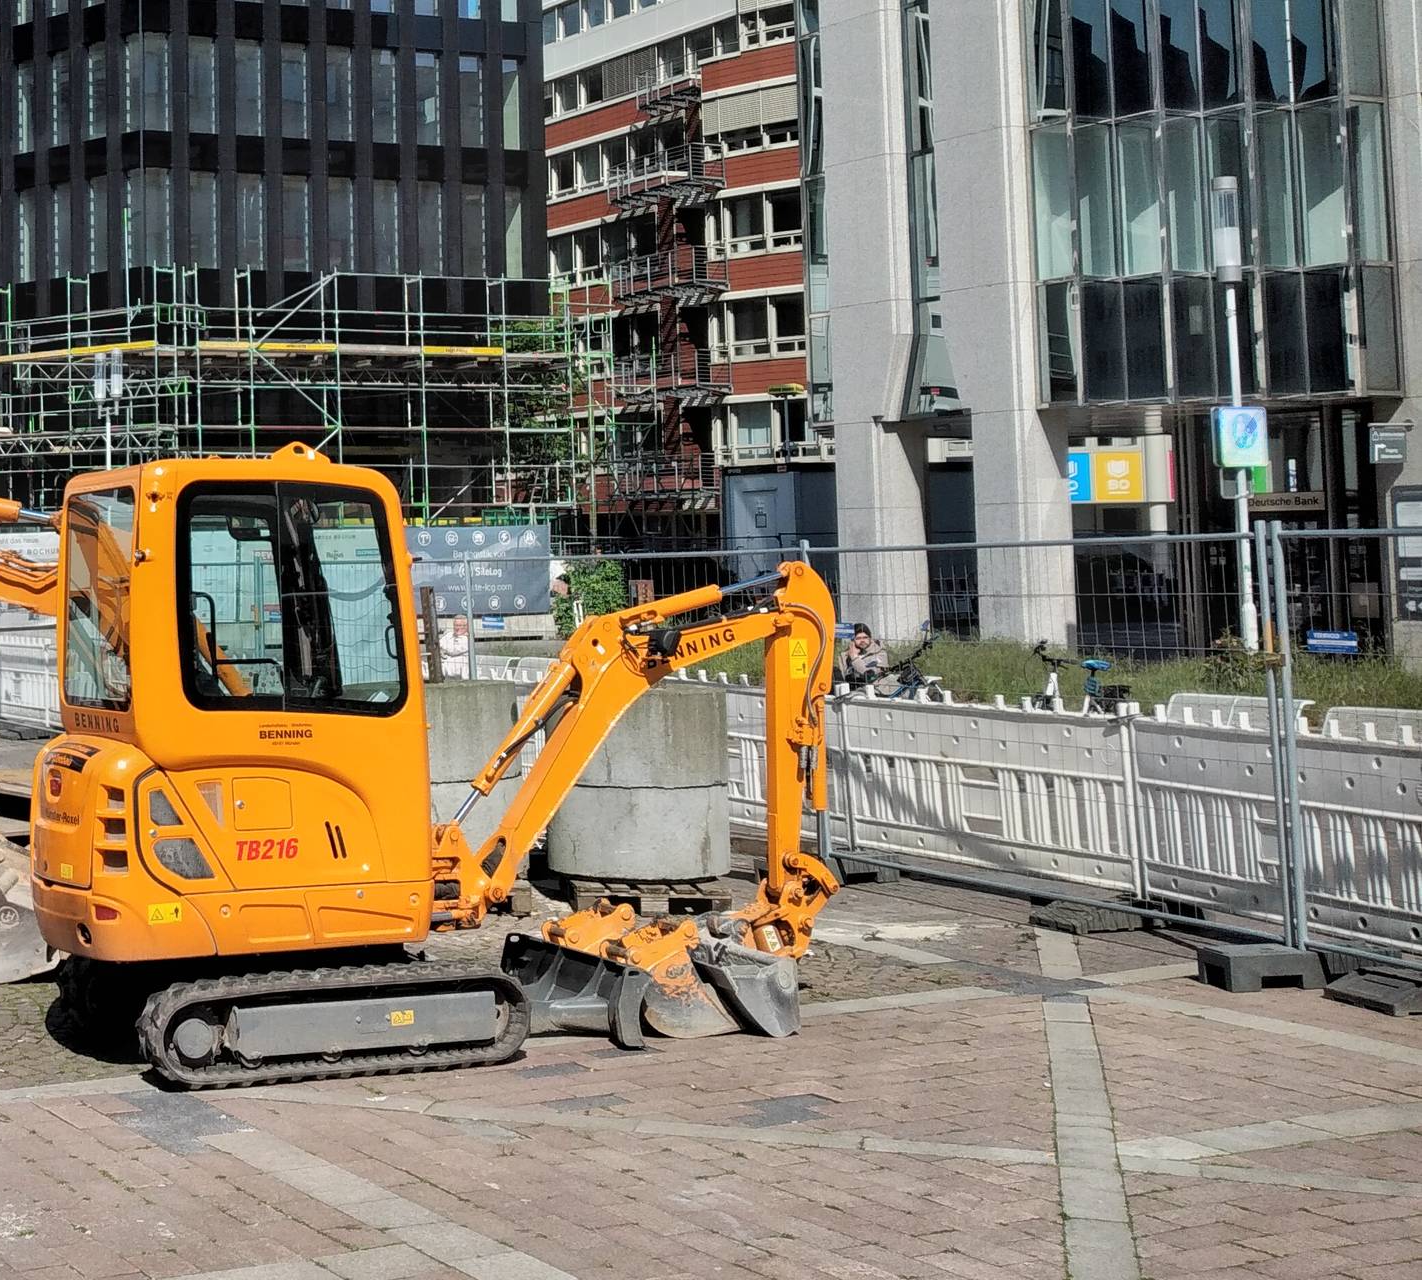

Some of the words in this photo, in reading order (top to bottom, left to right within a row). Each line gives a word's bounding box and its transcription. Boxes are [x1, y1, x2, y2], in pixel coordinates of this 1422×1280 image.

[1295, 496, 1319, 506] Bank
[74, 711, 121, 734] BENNING
[259, 729, 314, 740] BENNING
[236, 837, 299, 861] TB216
